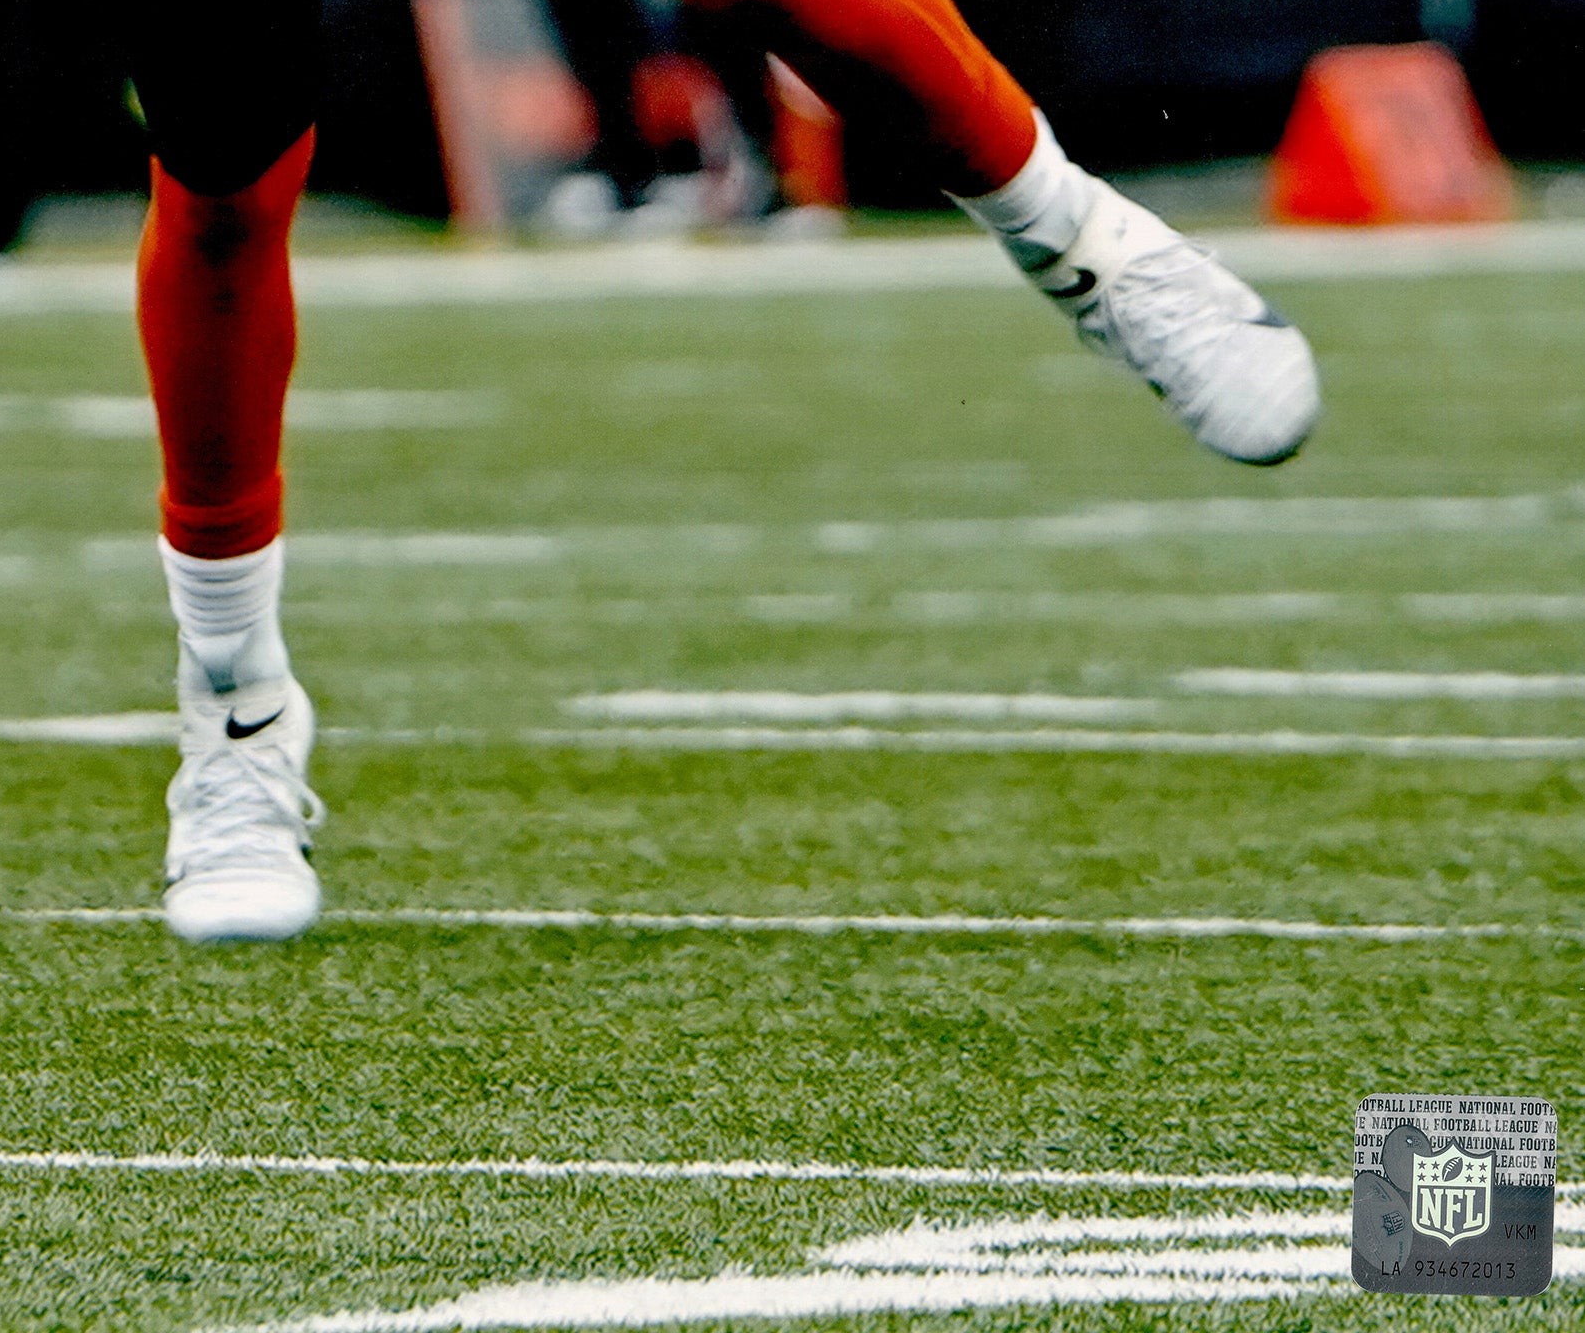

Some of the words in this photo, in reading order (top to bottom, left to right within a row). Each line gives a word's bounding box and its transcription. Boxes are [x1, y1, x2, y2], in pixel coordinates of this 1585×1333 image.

[1409, 1099, 1452, 1114] LEAGUE
[1459, 1101, 1515, 1115] NATIONAL
[1372, 1117, 1429, 1131] NATIONAL
[1434, 1118, 1491, 1132] FOOTBALL
[1495, 1120, 1538, 1133] LEAGUE
[1458, 1136, 1514, 1151] NATIONAL
[1419, 1188, 1483, 1235] NFL
[1504, 1223, 1537, 1240] VKM
[1381, 1261, 1401, 1276] LA
[1414, 1260, 1516, 1279] 934672013
